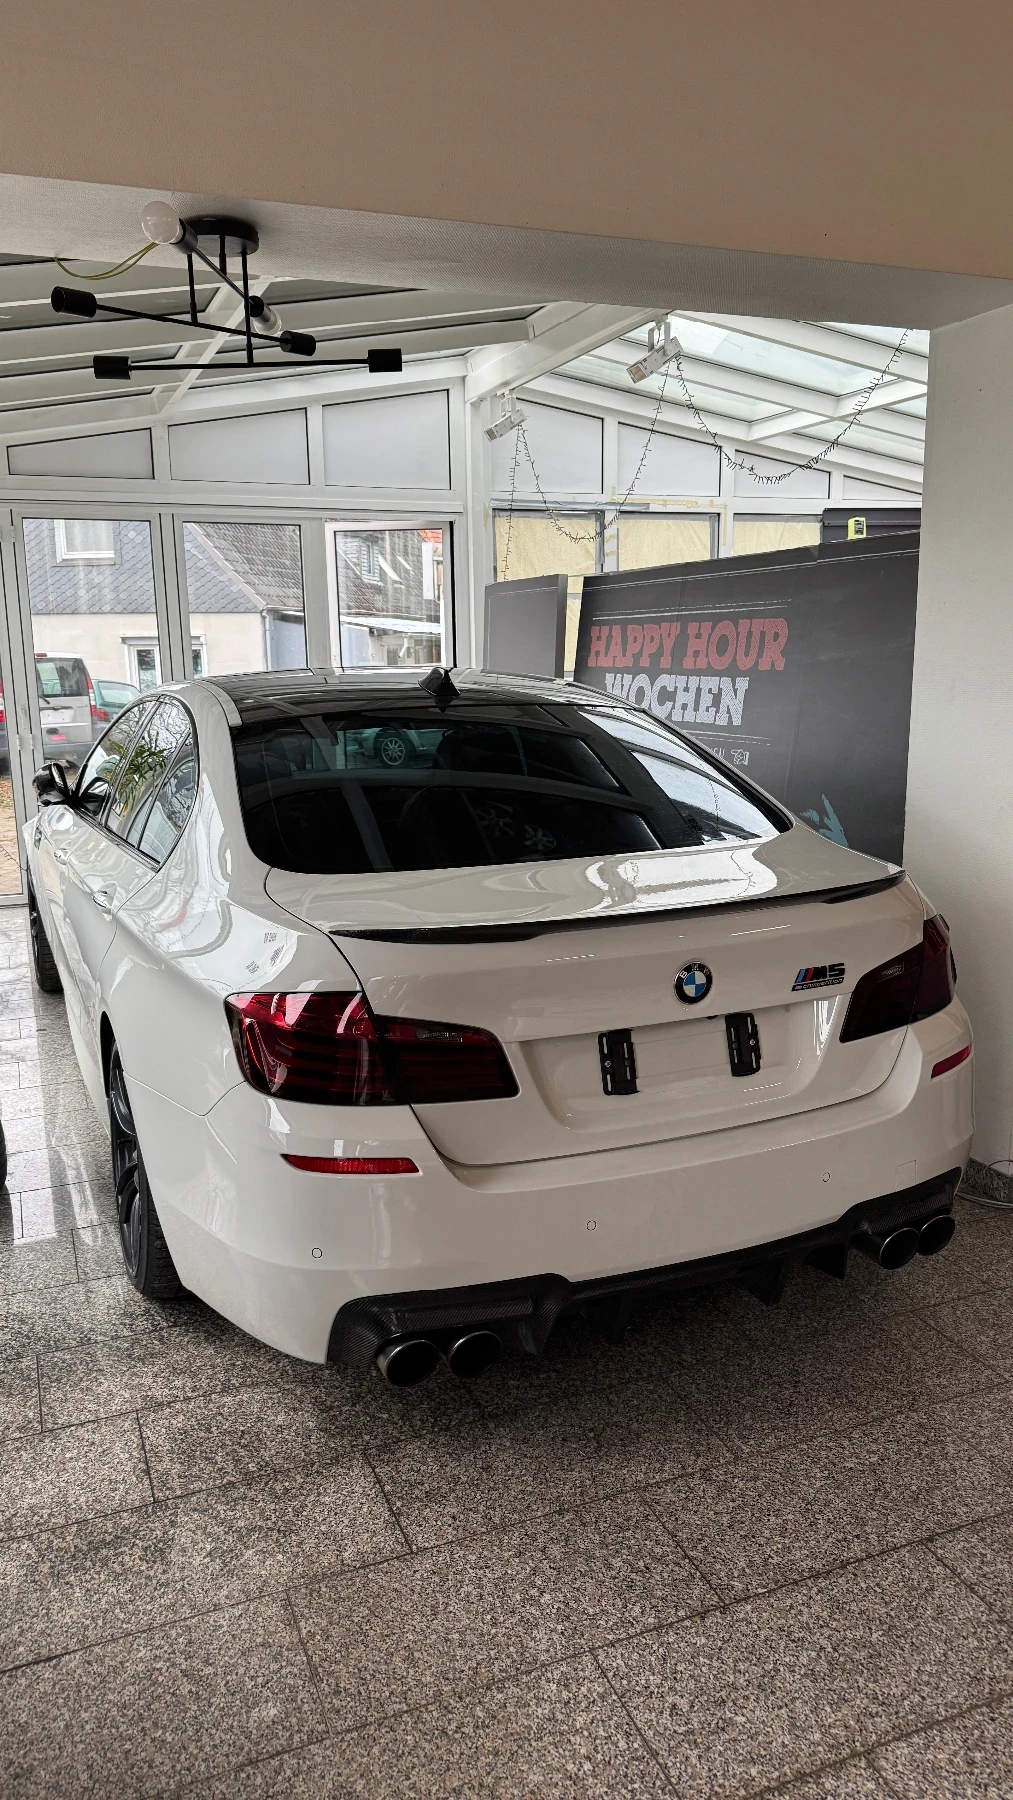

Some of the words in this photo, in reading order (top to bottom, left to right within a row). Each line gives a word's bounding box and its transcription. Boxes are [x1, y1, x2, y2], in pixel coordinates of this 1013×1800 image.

[588, 622, 680, 668] HAPPY
[682, 618, 788, 671] HOUR
[605, 673, 749, 725] WOCHEN
[803, 963, 846, 982] M5
